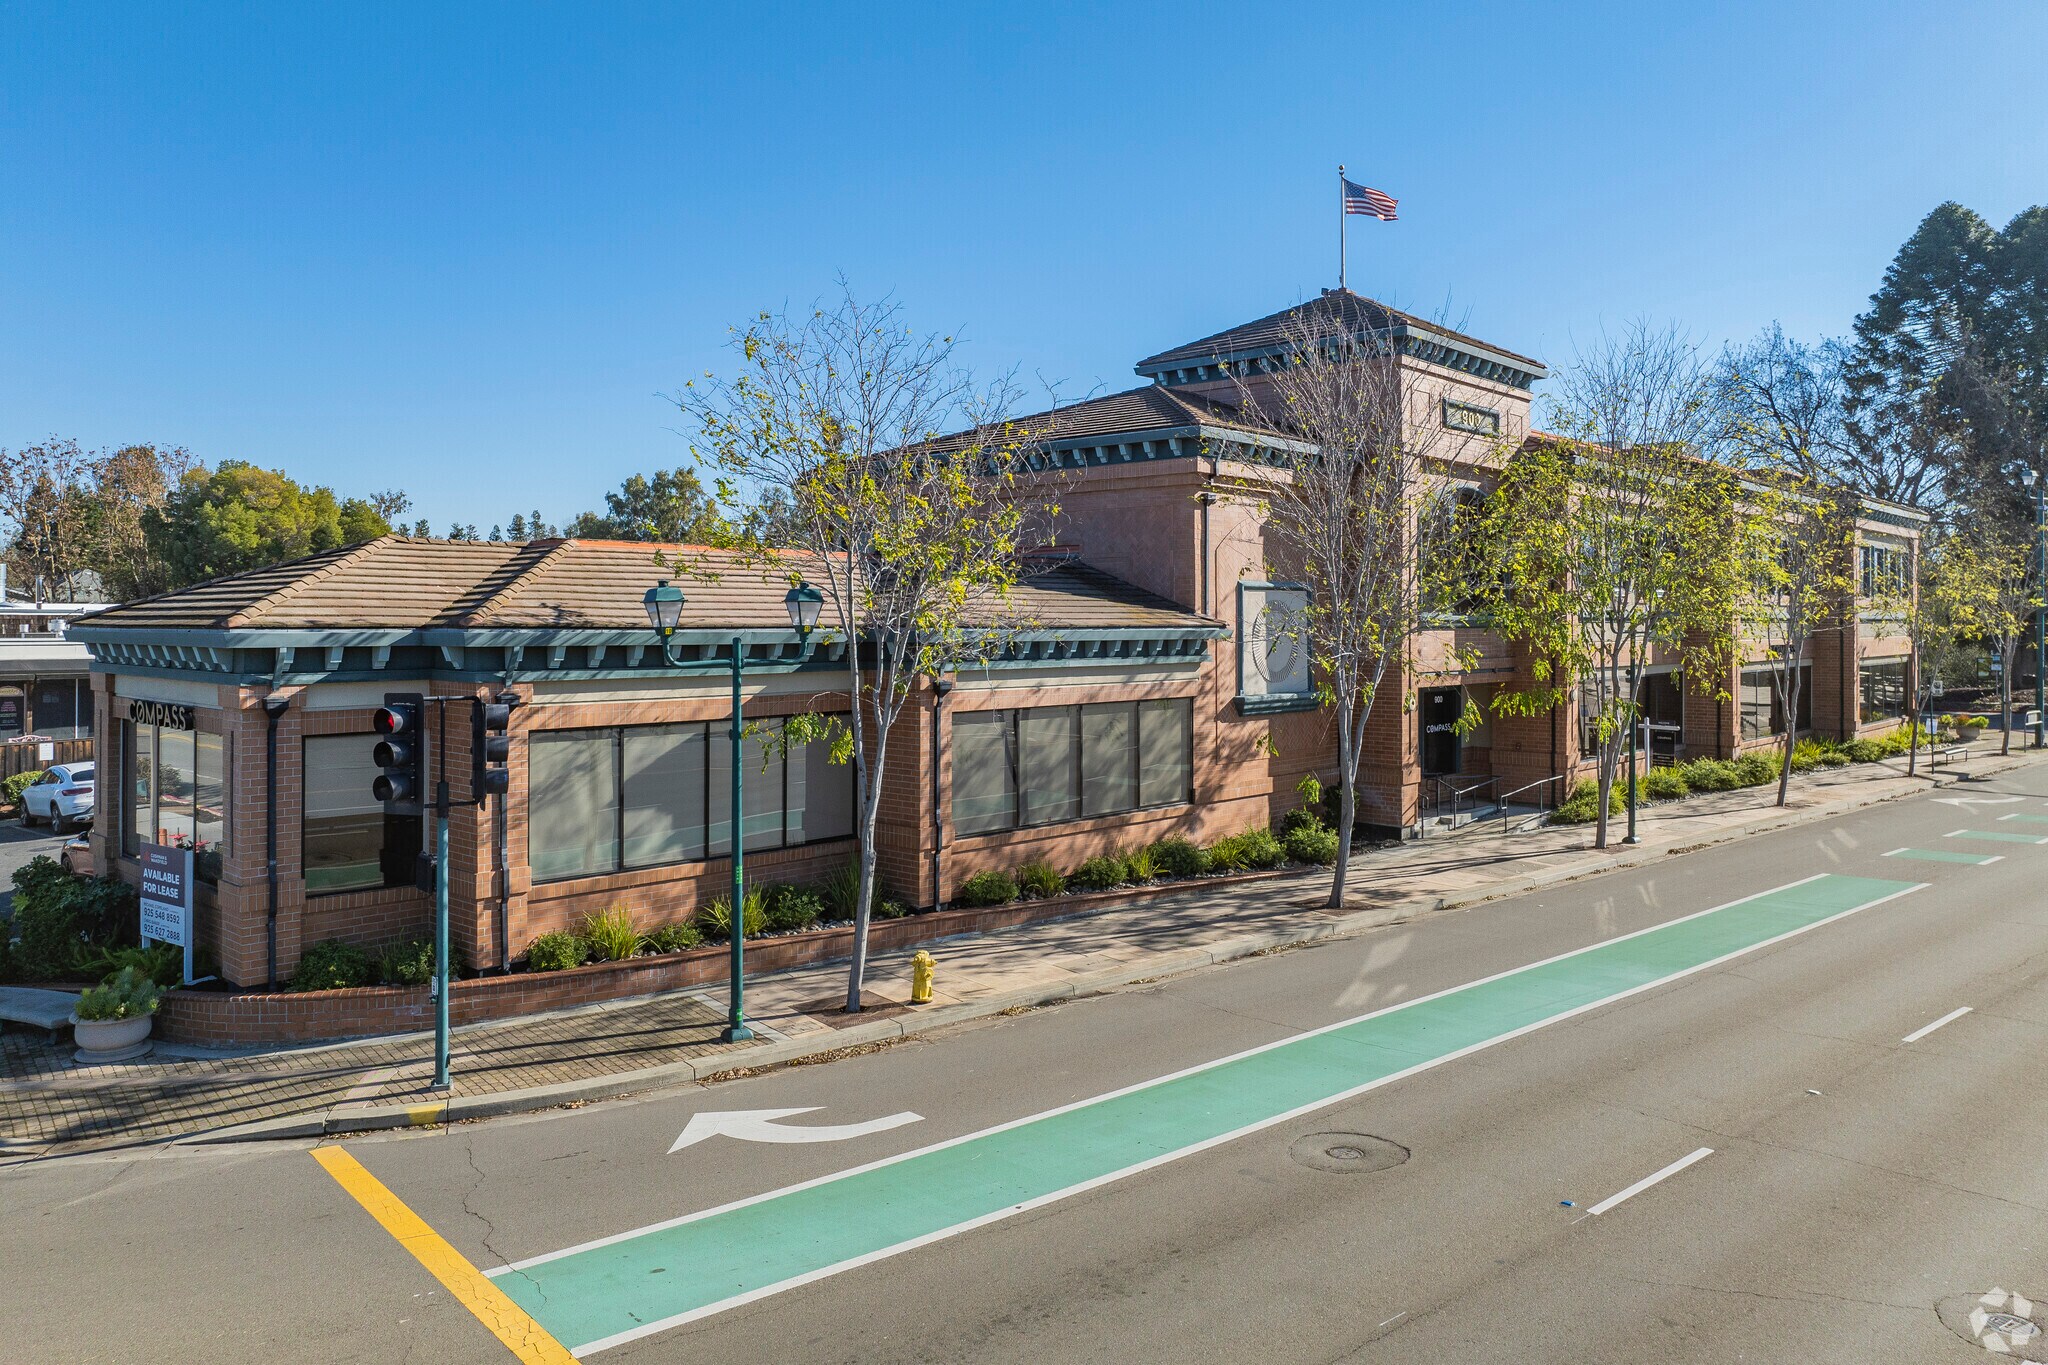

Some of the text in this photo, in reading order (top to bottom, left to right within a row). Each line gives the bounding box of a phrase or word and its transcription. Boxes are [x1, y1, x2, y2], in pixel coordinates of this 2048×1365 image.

[1462, 410, 1481, 427] 900
[1434, 695, 1444, 703] 900
[129, 700, 186, 731] COMPASS
[1426, 723, 1451, 733] COMPASS
[143, 868, 180, 885] AVAILABLE
[143, 881, 179, 899] FOR LEASE
[144, 907, 154, 917] 925
[155, 910, 166, 921] 548
[166, 912, 180, 924] 8592
[144, 924, 181, 941] 925 627 2888
